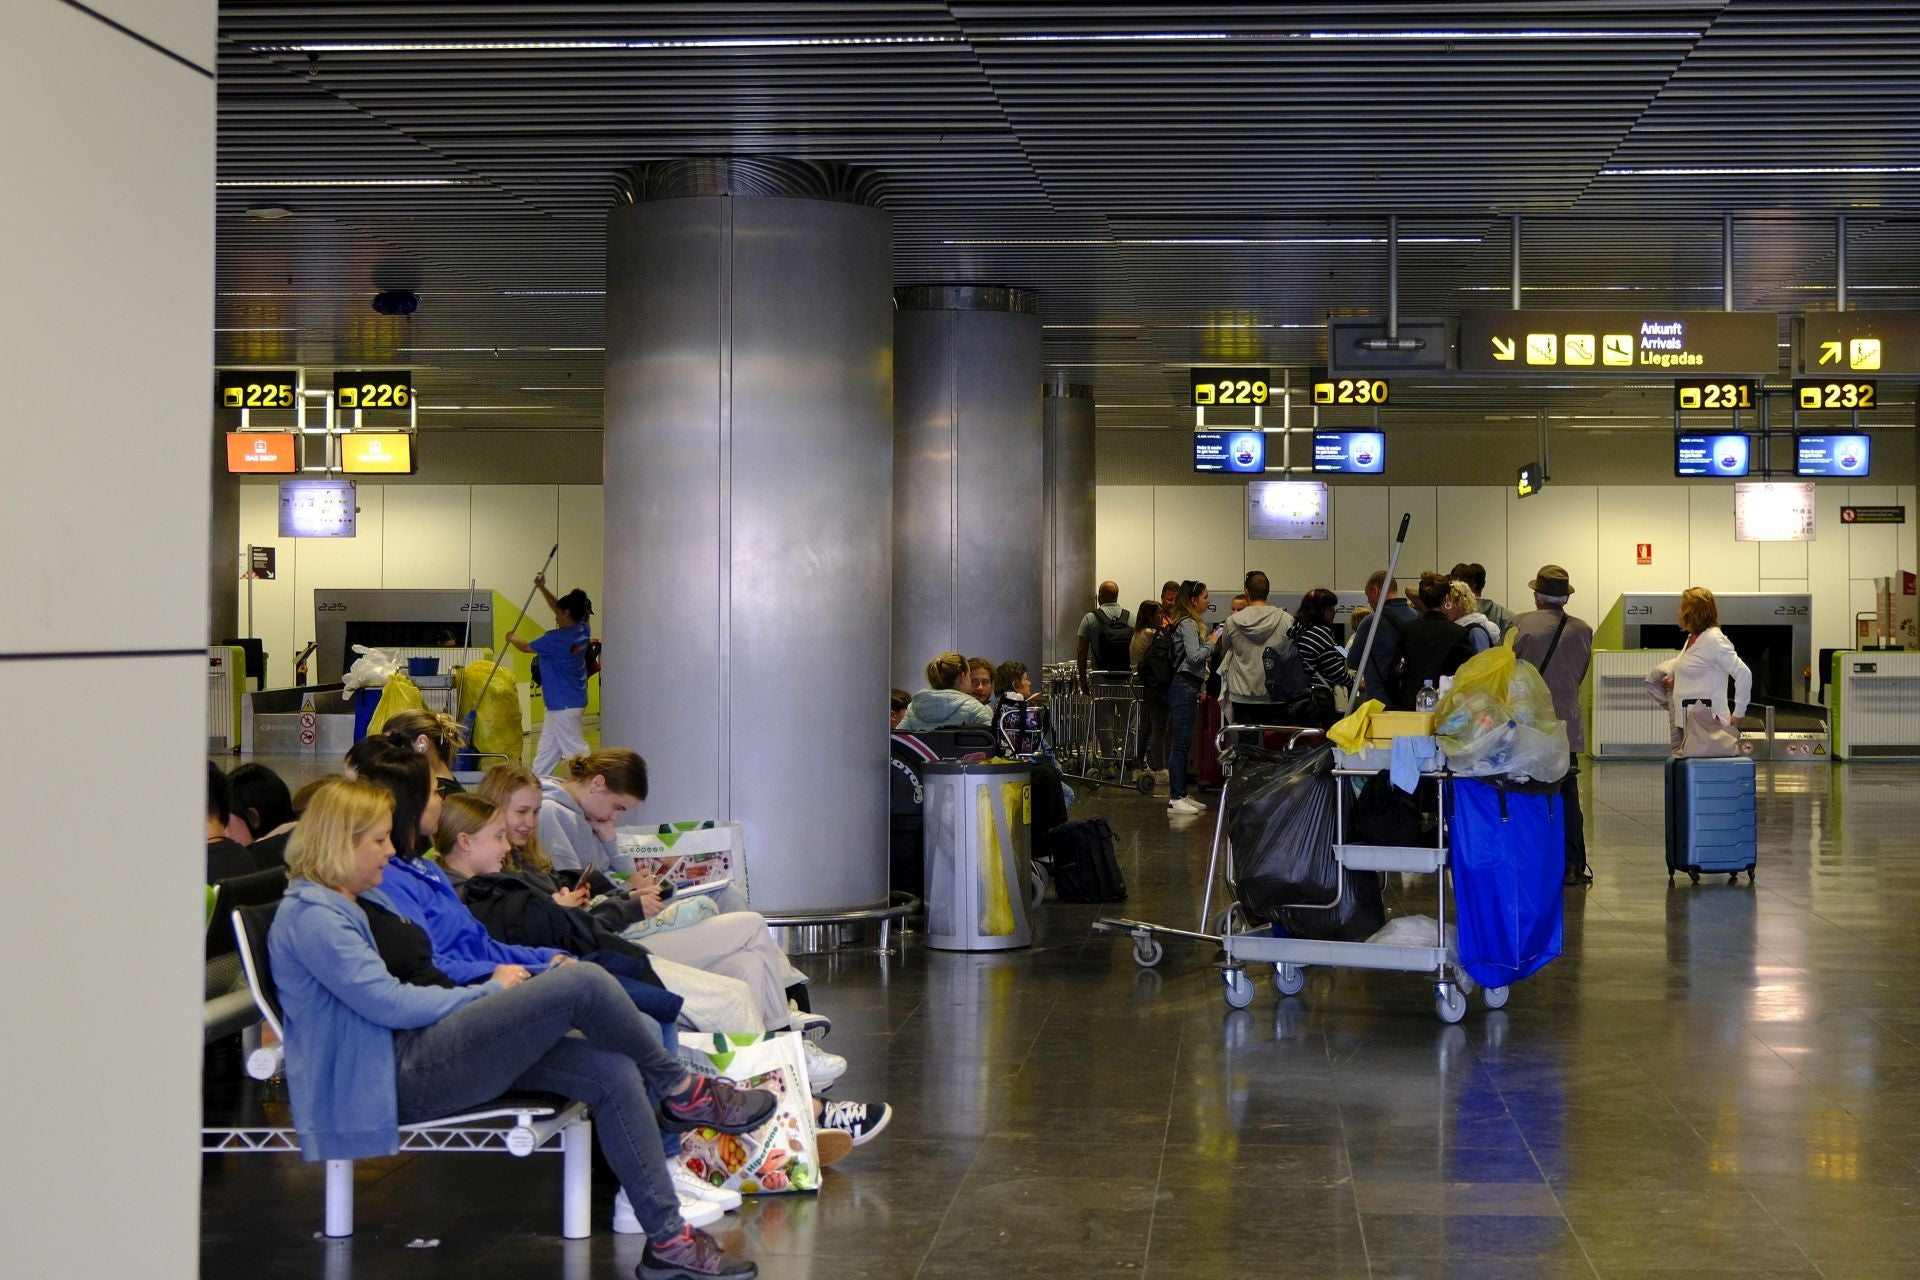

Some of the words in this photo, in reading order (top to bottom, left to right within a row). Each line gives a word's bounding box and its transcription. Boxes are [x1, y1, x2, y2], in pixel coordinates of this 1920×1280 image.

[1641, 322, 1682, 335] Ankunft
[1641, 337, 1682, 349] Arrivals
[1641, 351, 1703, 367] Llegadas
[247, 384, 293, 407] 225
[361, 384, 408, 407] 226
[1219, 380, 1268, 403] 229
[1338, 380, 1388, 403] 230
[1704, 384, 1751, 408] 231
[1824, 384, 1874, 408] 232
[318, 603, 347, 612] 225
[460, 603, 490, 612] 226
[1627, 606, 1652, 615] 231
[1774, 606, 1808, 616] 232
[746, 1126, 779, 1173] HiperDino
